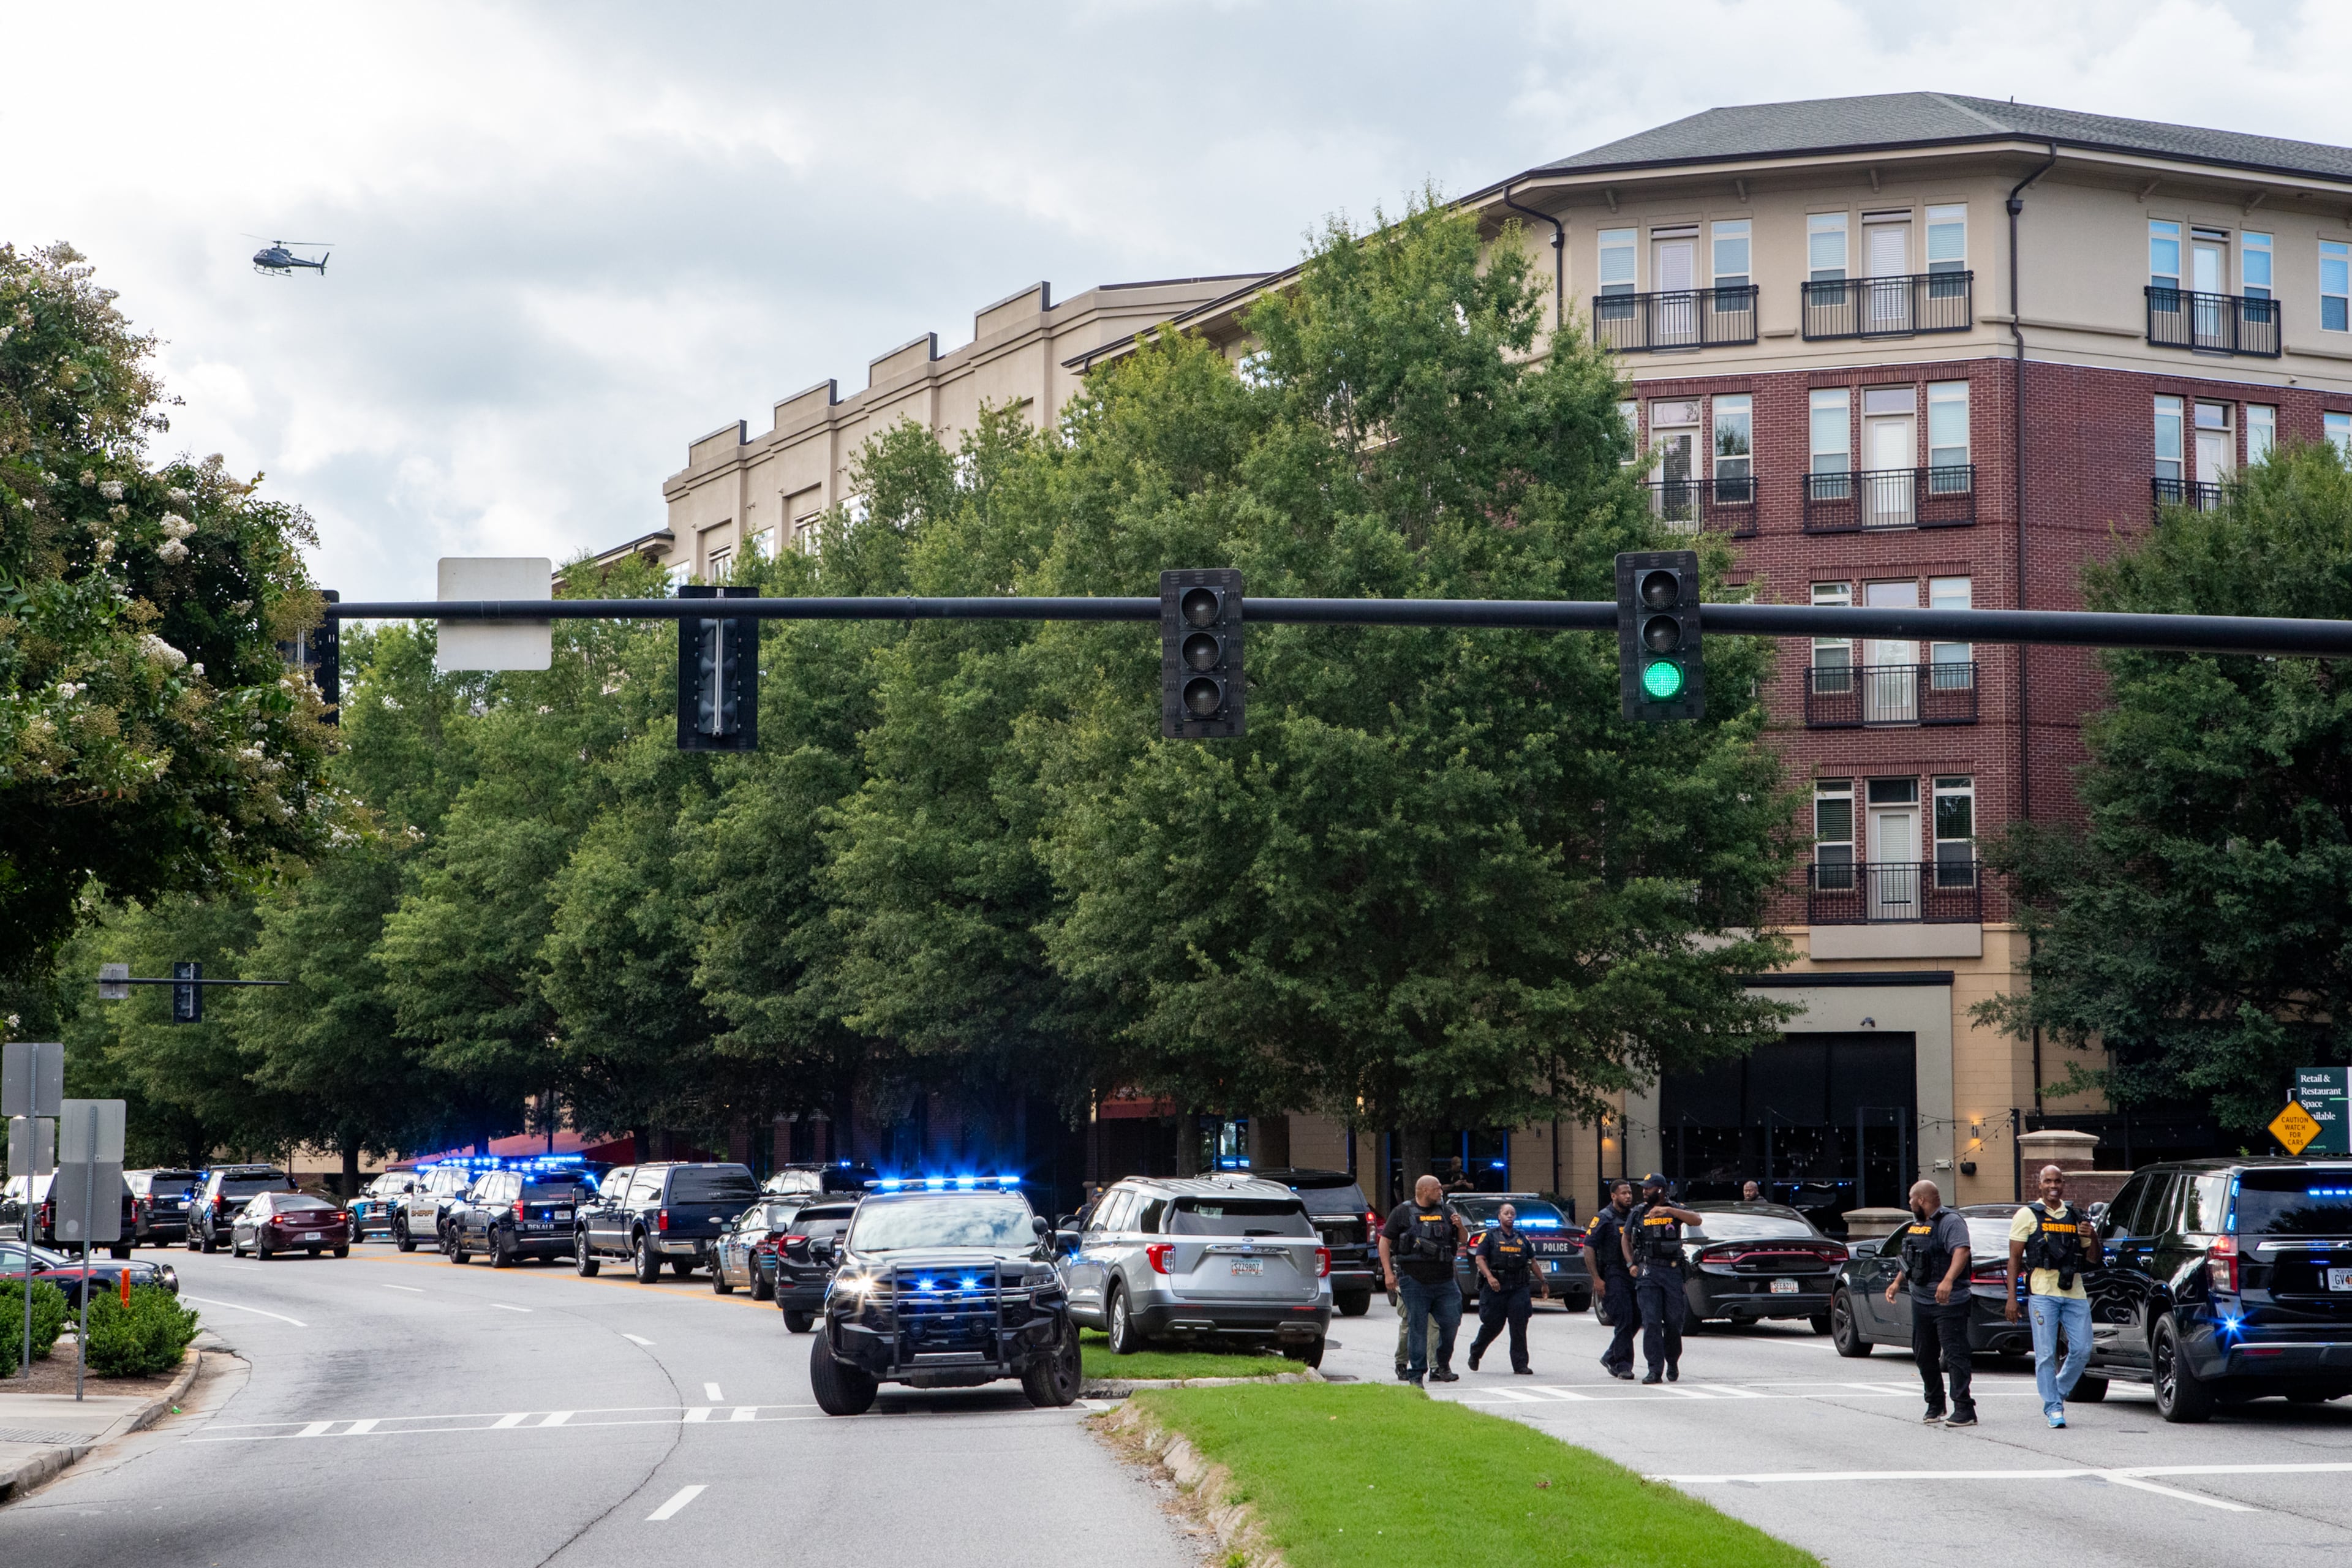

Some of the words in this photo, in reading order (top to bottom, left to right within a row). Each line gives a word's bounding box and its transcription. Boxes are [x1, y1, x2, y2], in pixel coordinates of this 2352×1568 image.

[2301, 1099, 2323, 1109] Space
[2311, 1112, 2335, 1120] ailable
[1643, 1218, 1673, 1226] SHERIFF
[2041, 1223, 2076, 1233] SHERIFF
[1543, 1243, 1568, 1252] POLICE
